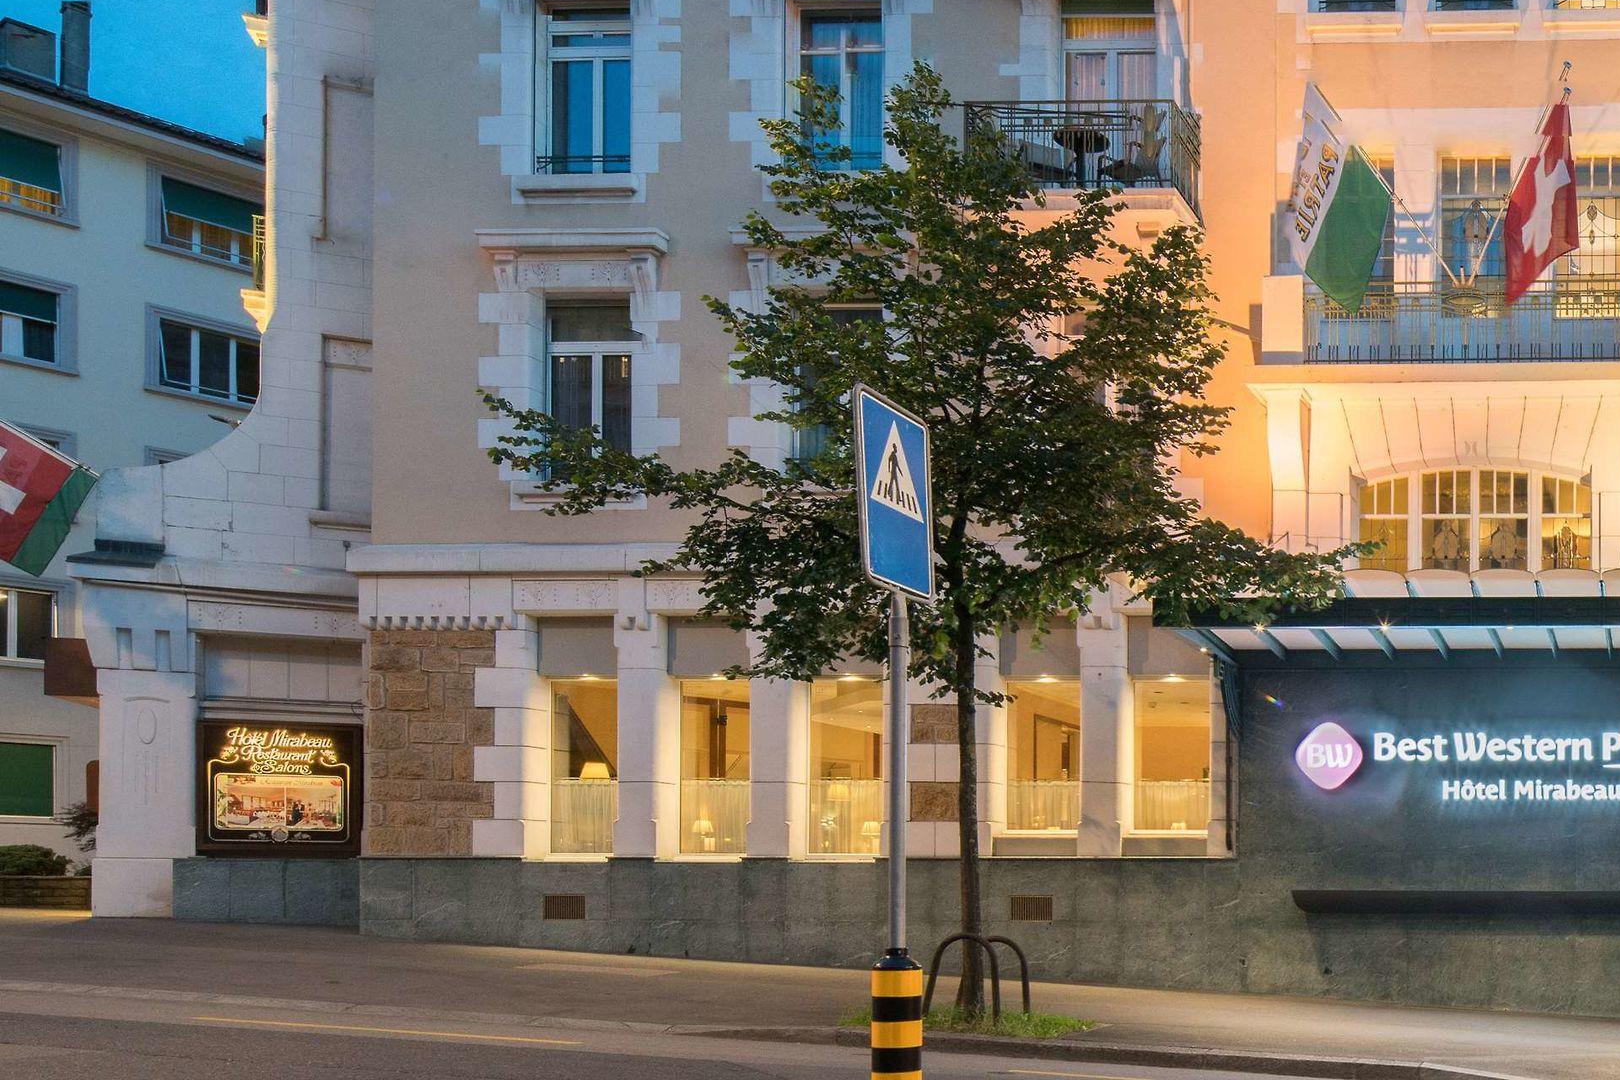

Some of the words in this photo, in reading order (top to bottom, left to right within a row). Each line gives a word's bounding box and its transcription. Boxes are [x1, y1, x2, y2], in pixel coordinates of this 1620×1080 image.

[227, 727, 269, 748] Hôtel
[268, 729, 332, 748] Mirabeau
[1373, 732, 1449, 762] Best
[1453, 732, 1594, 763] Western
[241, 744, 317, 764] Restaurant
[1307, 743, 1353, 770] BW
[1442, 779, 1507, 801] Hôtel
